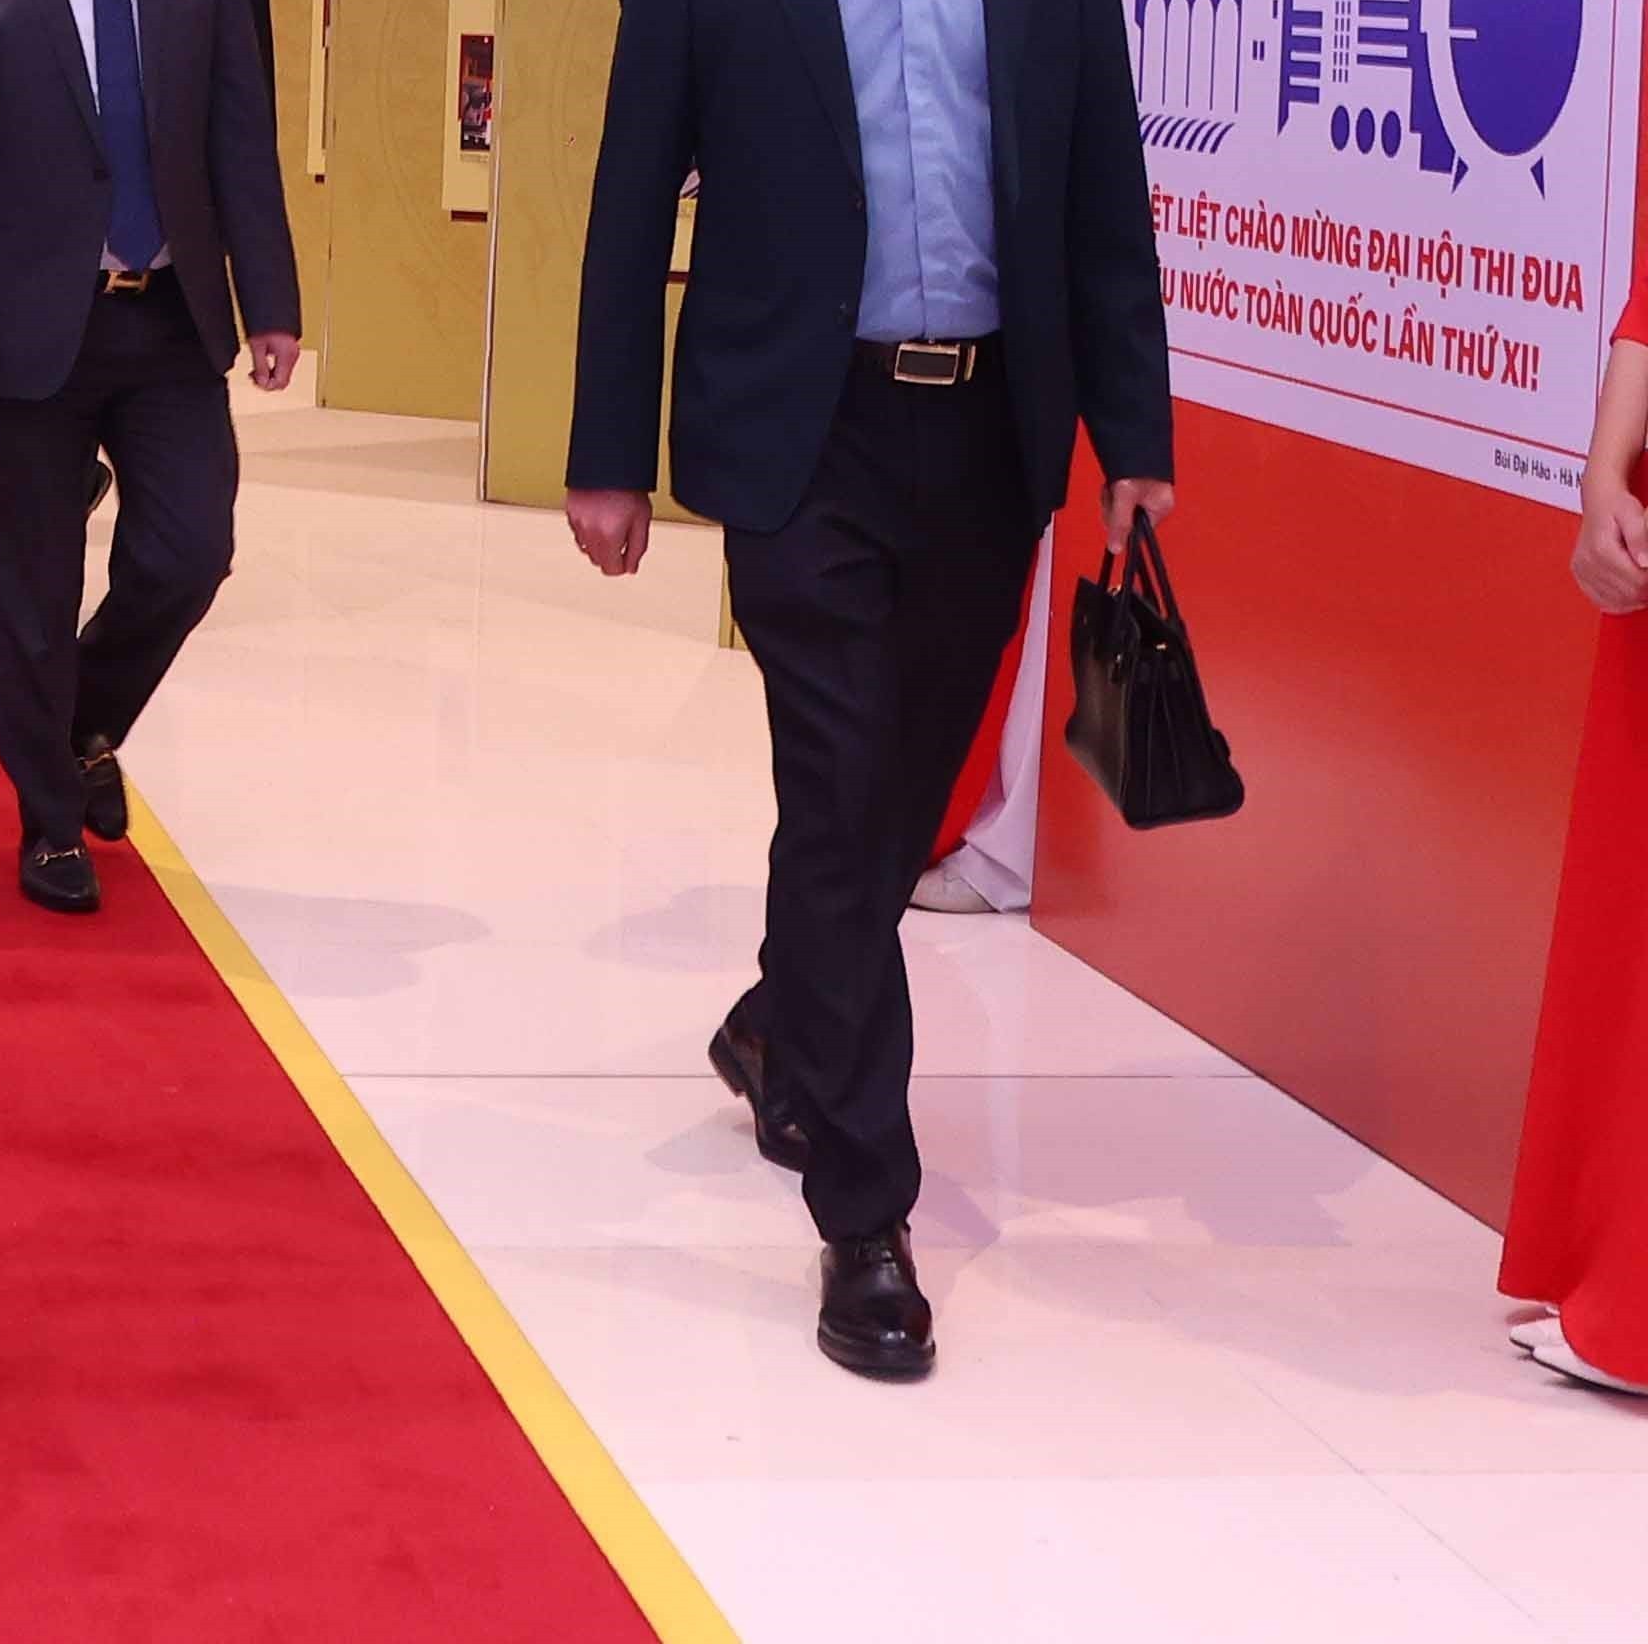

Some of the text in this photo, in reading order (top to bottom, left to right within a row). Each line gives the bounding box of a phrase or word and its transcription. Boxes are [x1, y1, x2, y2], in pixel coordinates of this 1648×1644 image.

[1178, 191, 1221, 250] LIỆT
[1225, 199, 1285, 254] CHÀO
[1291, 209, 1362, 269] MỪNG
[1368, 229, 1410, 288] ĐẠI
[1417, 230, 1463, 299] HỘI
[1470, 246, 1515, 298] THI
[1522, 255, 1584, 313] ĐUA
[1180, 268, 1240, 322] NƯỚC
[1244, 279, 1303, 336] TOÀN
[1309, 292, 1378, 353] QUỐC
[1384, 303, 1435, 367] LẦN
[1441, 325, 1499, 381] THỨ
[1501, 338, 1540, 392] XI!
